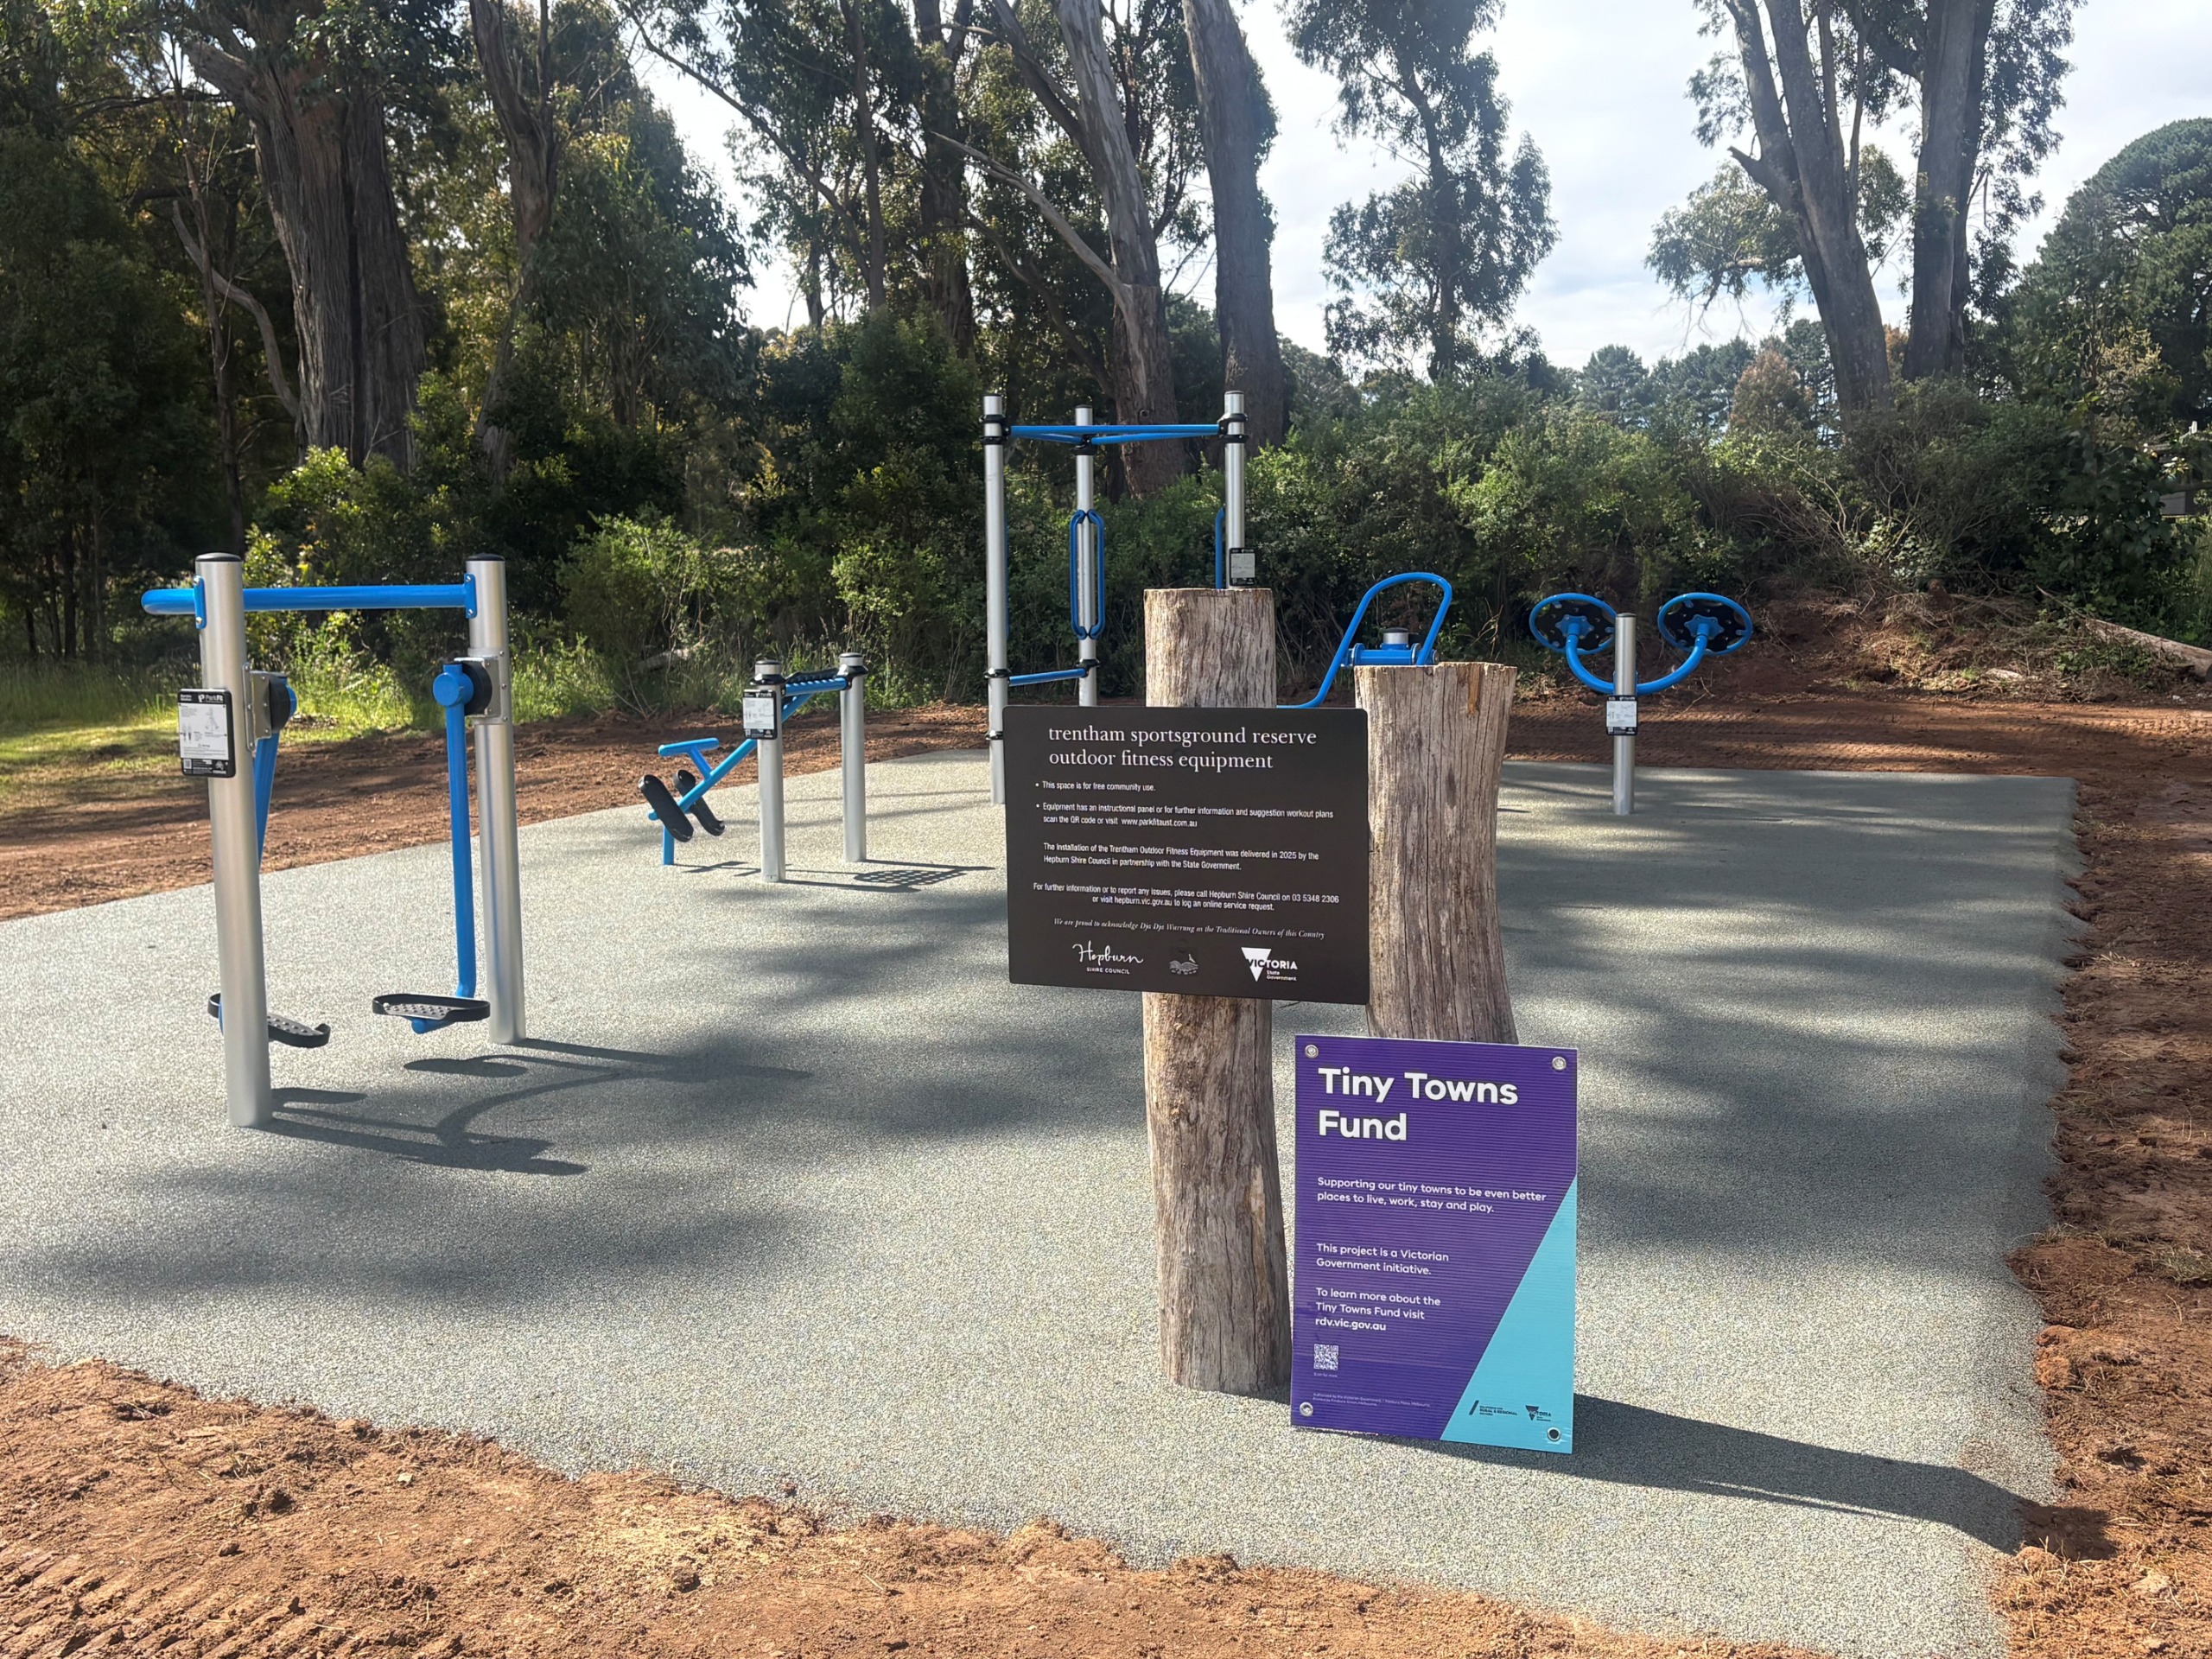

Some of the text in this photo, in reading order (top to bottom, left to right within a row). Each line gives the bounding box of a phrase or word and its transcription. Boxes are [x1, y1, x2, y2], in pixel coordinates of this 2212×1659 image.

[1049, 726, 1317, 747] trentham sportsground reserve
[1049, 749, 1274, 772] outdoor fitness equipment
[1107, 783, 1141, 792] community
[1043, 803, 1075, 811] Equipment
[1198, 807, 1235, 816] information
[1249, 808, 1285, 817] suggestion
[1315, 810, 1333, 819] plans
[1044, 855, 1070, 863] Hepburn
[1088, 856, 1110, 865] Council
[1120, 858, 1155, 868] partnership
[1202, 861, 1242, 870] Government.
[1141, 846, 1164, 855] Outdoor
[1166, 847, 1188, 855] Fitness
[1190, 848, 1224, 857] Equipment
[1299, 852, 1306, 861] by
[1115, 897, 1172, 906] hepburn.vic.gov.au
[1182, 899, 1192, 908] log
[1151, 888, 1172, 897] issues,
[1210, 891, 1236, 899] Hepburn
[1102, 921, 1139, 930] acknowledge
[1278, 928, 1286, 938] of
[1299, 931, 1325, 940] Country
[1072, 940, 1144, 965] Hepburn
[1245, 958, 1298, 969] VICTORIA
[1319, 1067, 1518, 1104] Tiny Towns
[1319, 1110, 1407, 1141] Fund
[1318, 1177, 1547, 1201] Supporting our tiny towns to be even better
[1318, 1192, 1495, 1213] places to live, work, stay and play.
[1317, 1243, 1338, 1253] This
[1340, 1246, 1377, 1257] project
[1380, 1247, 1389, 1256] is
[1401, 1249, 1449, 1262] Victorian
[1317, 1258, 1432, 1274] Government initiative.
[1316, 1287, 1441, 1306] To learn more about the
[1316, 1302, 1425, 1319] Tiny Towns Fund visit
[1315, 1317, 1386, 1330] rdv.vic.gov.au
